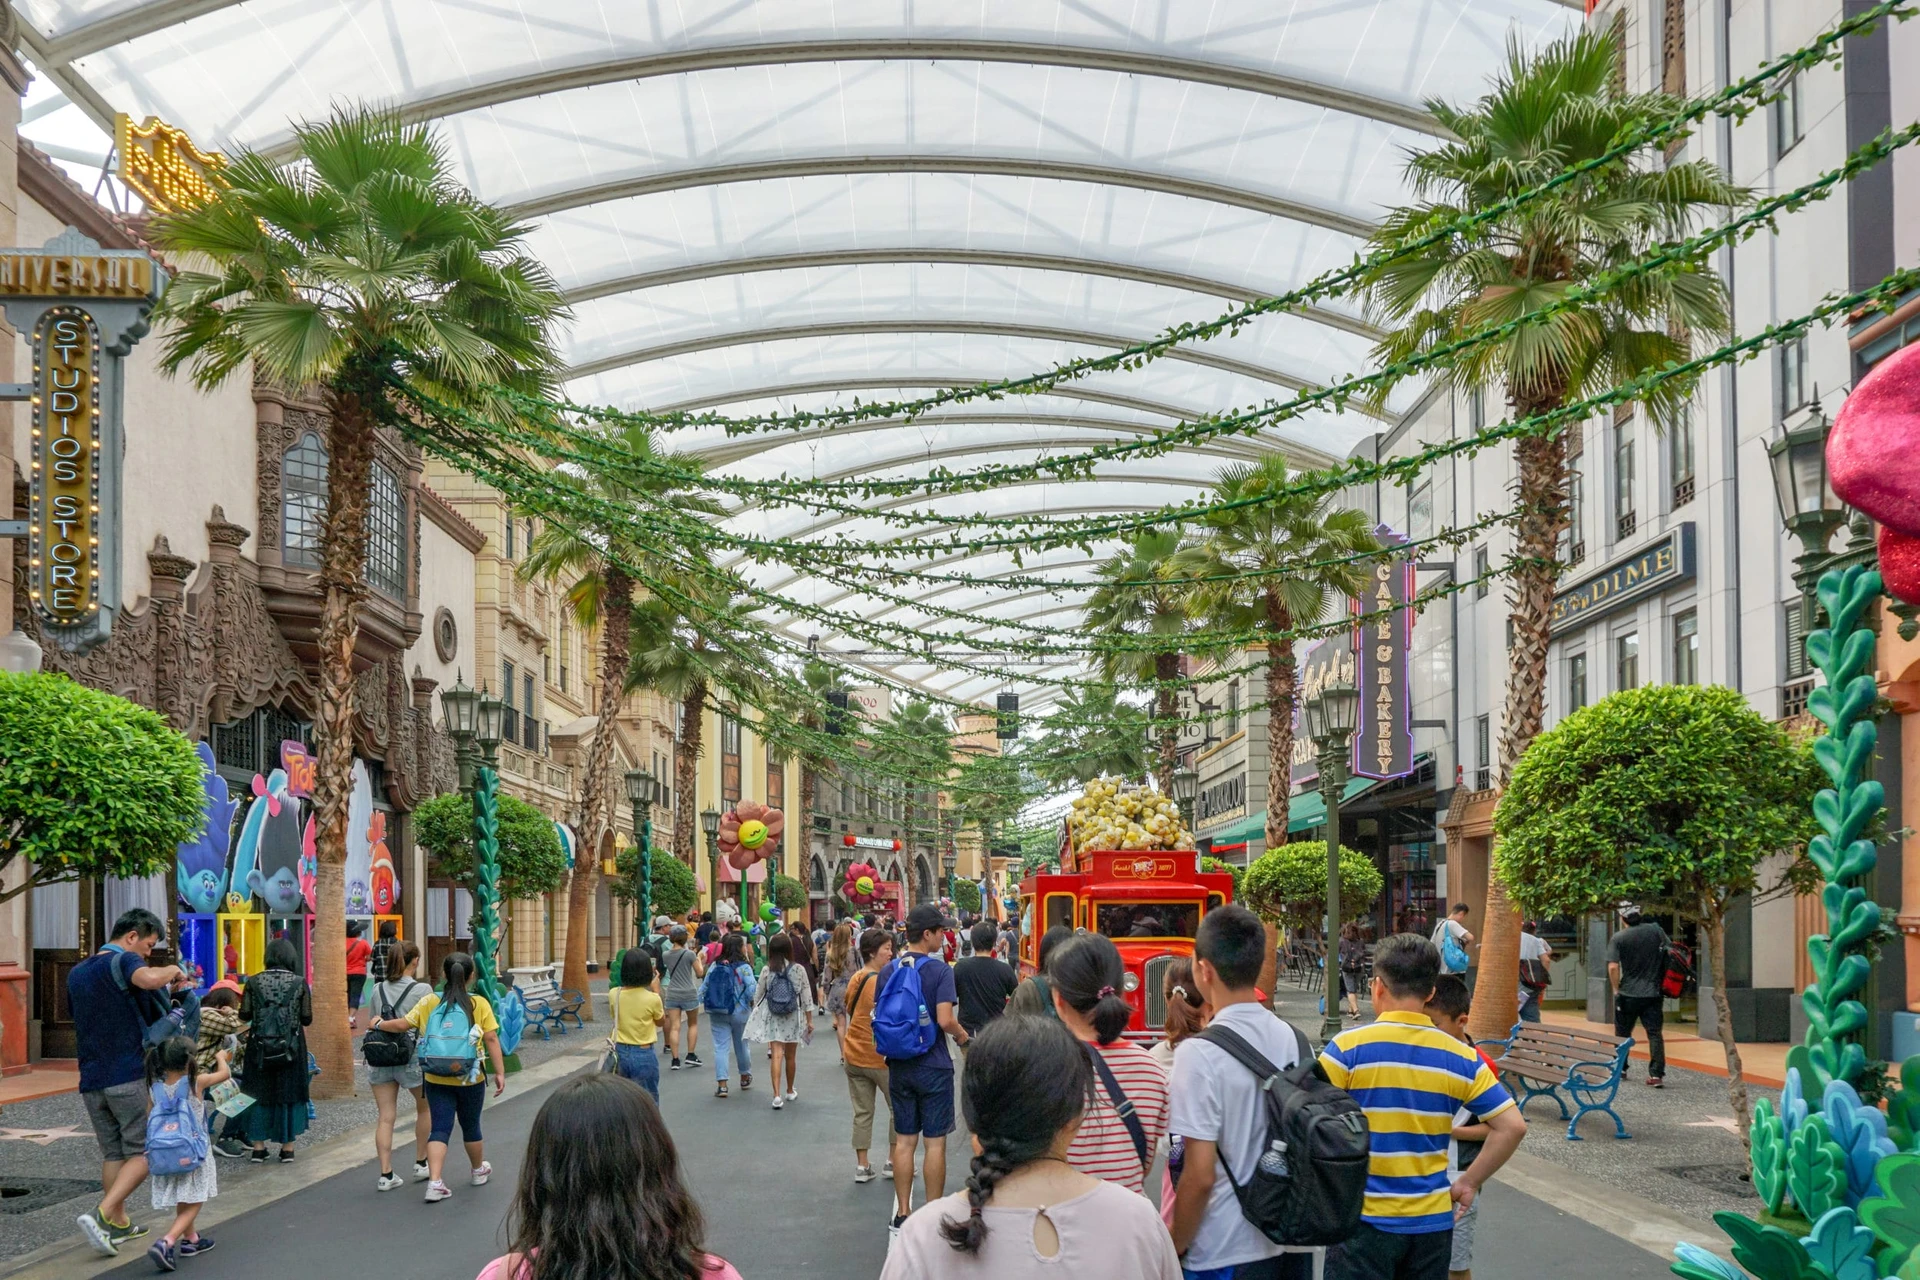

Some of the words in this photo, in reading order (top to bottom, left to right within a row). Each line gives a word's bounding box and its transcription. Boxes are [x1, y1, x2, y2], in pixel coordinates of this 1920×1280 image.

[51, 320, 81, 481] STUDIOS
[51, 495, 81, 609] STORE
[1592, 544, 1673, 602] DIME
[1376, 645, 1393, 662] &
[1376, 667, 1393, 775] BAKERY
